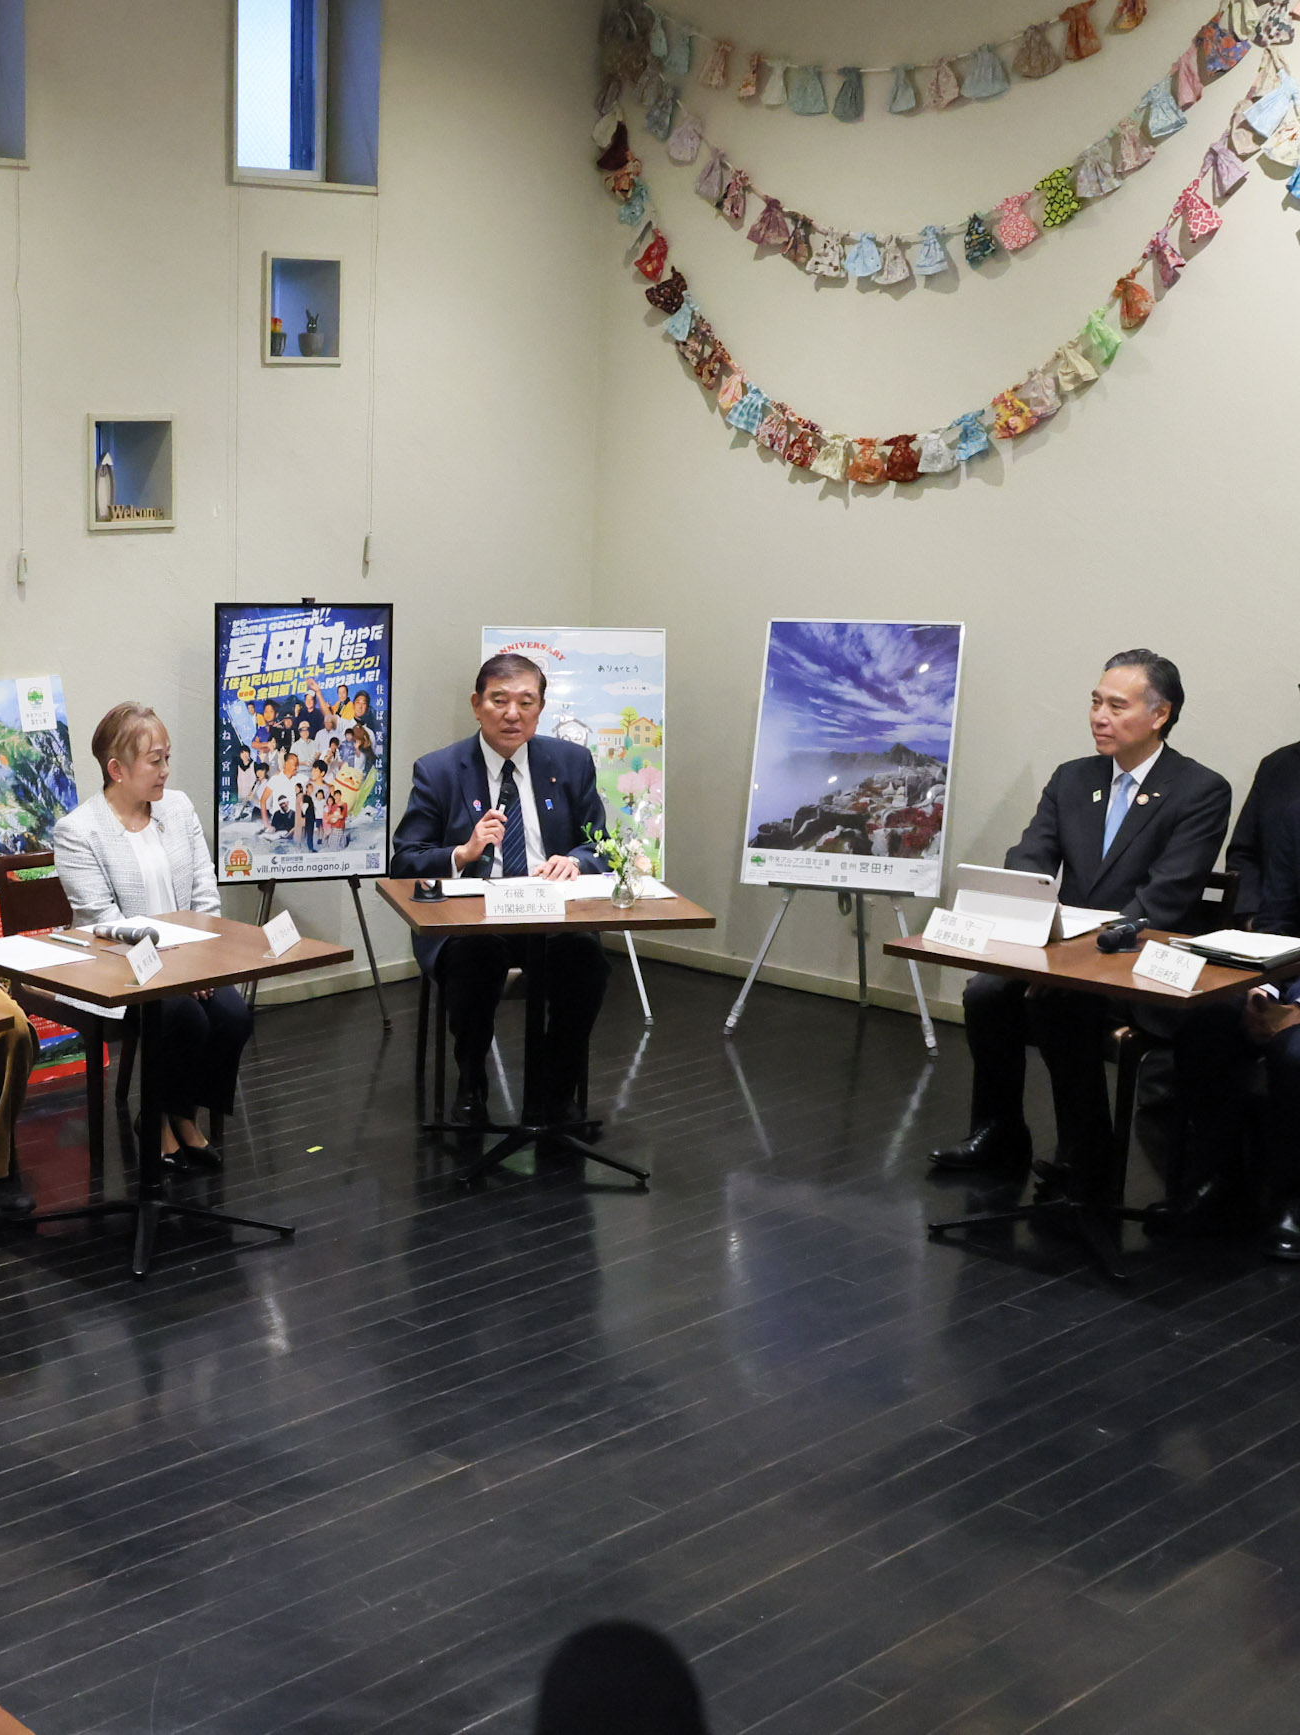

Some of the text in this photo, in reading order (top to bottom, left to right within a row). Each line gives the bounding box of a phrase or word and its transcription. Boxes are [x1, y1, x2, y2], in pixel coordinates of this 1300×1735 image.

[108, 504, 164, 520] Welcome
[341, 624, 384, 645] みやだ
[225, 620, 346, 677] 宮田村
[339, 642, 367, 660] むら
[495, 641, 567, 661] NNIVERSARY
[597, 664, 639, 673] ありがとう
[257, 861, 351, 874] vill.miyada.nagano.jp
[859, 862, 894, 875] 宮田村
[503, 887, 525, 899] 石破
[493, 902, 558, 914] 内閣総理大臣
